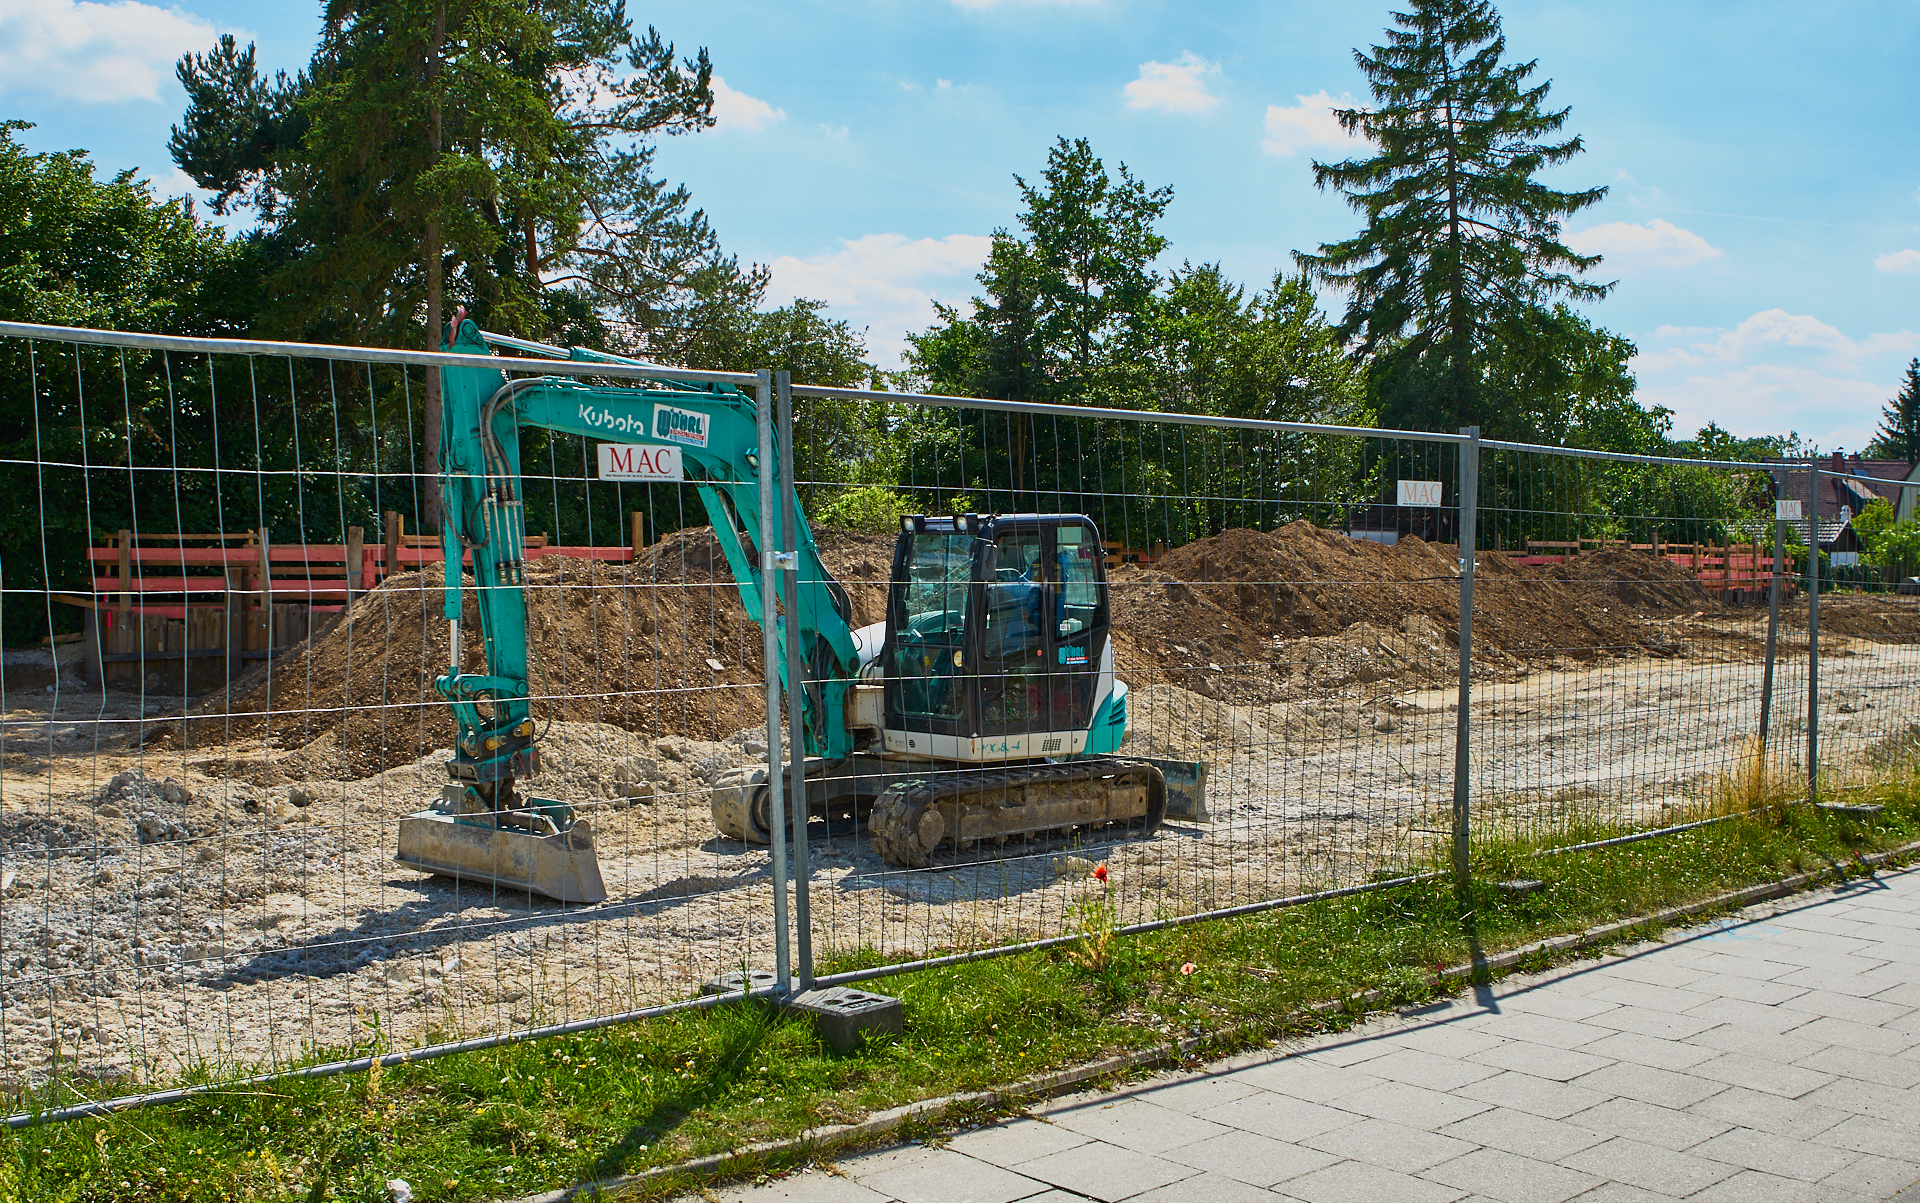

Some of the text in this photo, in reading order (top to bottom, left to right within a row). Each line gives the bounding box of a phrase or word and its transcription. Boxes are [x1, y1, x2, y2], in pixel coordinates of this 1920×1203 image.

[578, 403, 644, 436] Kubota
[608, 447, 672, 475] MAC
[1403, 482, 1441, 504] MAC
[1780, 501, 1801, 517] MAC
